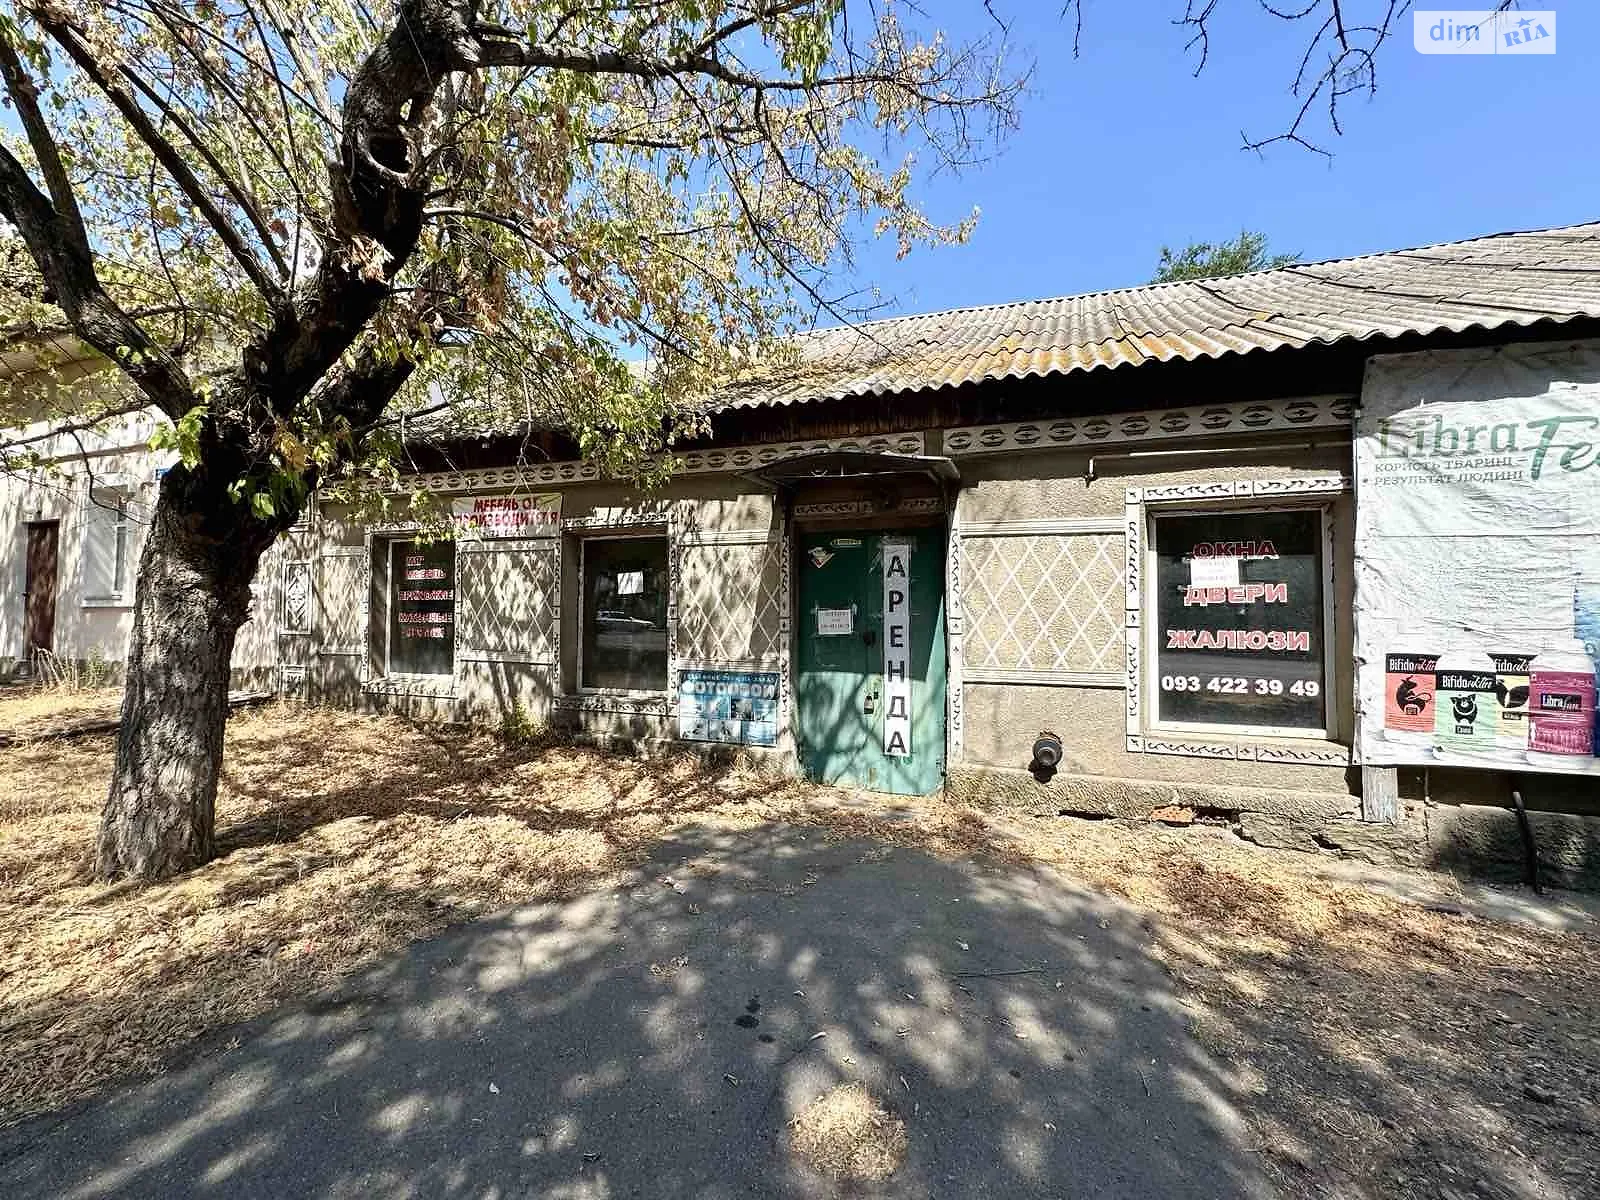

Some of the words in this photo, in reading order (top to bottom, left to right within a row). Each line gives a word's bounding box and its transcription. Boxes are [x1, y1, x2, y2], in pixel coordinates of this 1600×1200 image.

[1375, 414, 1520, 458] Libra
[1522, 416, 1600, 480] Fe
[1375, 462, 1440, 473] КОРИСТЬ
[1375, 474, 1451, 486] РЕЗУЛЬТАТ
[1192, 541, 1281, 560] ОКНА
[1183, 583, 1288, 607] ДВЕРИ
[1166, 629, 1310, 650] ЖАЛЮЗИ
[886, 555, 908, 755] АРЕНДА
[1161, 675, 1201, 692] 093
[1206, 677, 1249, 694] 422
[1255, 679, 1284, 695] 39
[1289, 680, 1320, 697] 49
